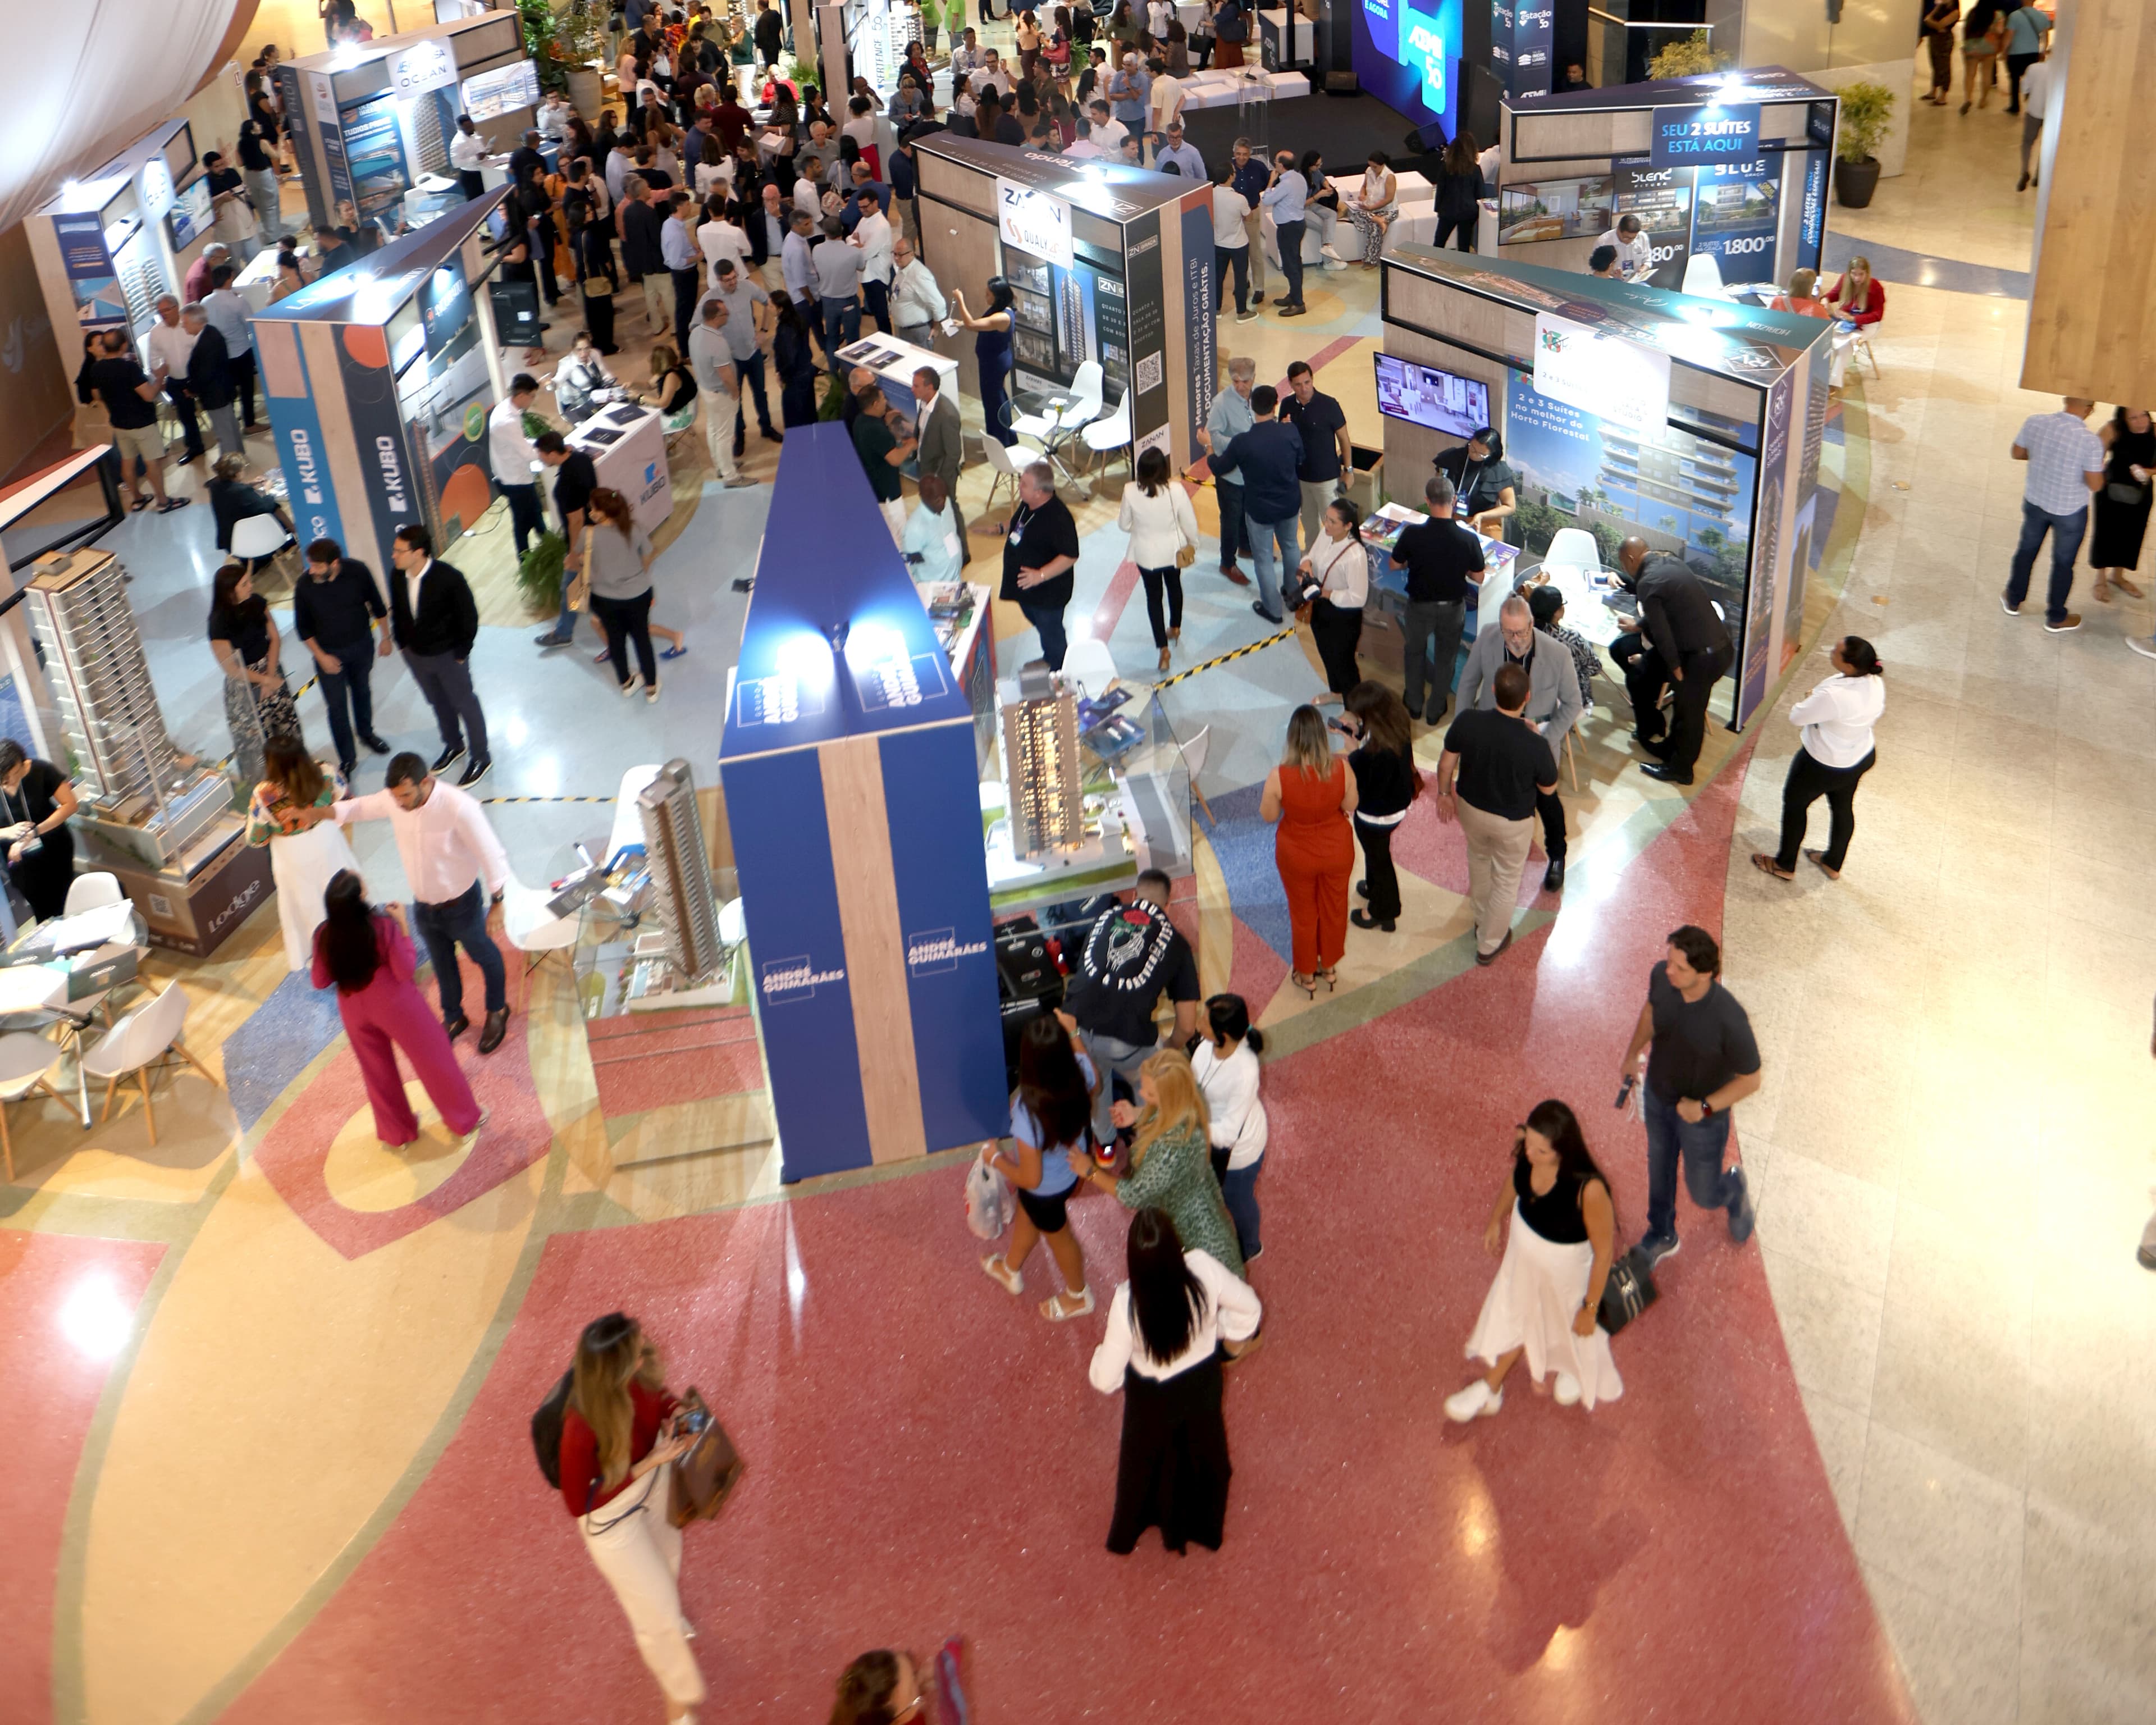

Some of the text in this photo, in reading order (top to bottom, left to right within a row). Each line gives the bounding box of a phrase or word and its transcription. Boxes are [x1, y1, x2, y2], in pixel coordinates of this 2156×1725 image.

[1369, 3, 1388, 20] AGORA
[1520, 10, 1552, 20] estação
[874, 38, 885, 84] SERTENGE
[401, 65, 446, 88] OCEAN
[1661, 119, 1752, 137] SEU 2 SUÍTES
[1668, 138, 1742, 153] ESTÁ AQUI
[1024, 152, 1075, 167] Tenda
[1024, 230, 1048, 250] QUALY
[1129, 245, 1140, 257] ZN
[1100, 280, 1116, 293] ZN
[1199, 262, 1209, 309] GRÁTIS.
[1101, 303, 1122, 314] QUARTO
[1193, 325, 1200, 340] de
[1746, 321, 1792, 336] HORIZON
[1201, 311, 1212, 411] DOCUMENTAÇÃO
[1515, 402, 1583, 429] no melhor do
[1547, 401, 1581, 418] Suítes
[1510, 410, 1590, 442] Horto Florestal
[1141, 430, 1164, 448] ZANAN
[290, 429, 319, 483] KUBO
[375, 436, 404, 491] KUBO
[640, 475, 665, 505] KUBO
[907, 936, 956, 958] ANDRÉ
[908, 941, 988, 966] GUIMARÃES
[762, 964, 812, 986] ANDRÉ
[763, 969, 844, 993] GUIMARÃES
